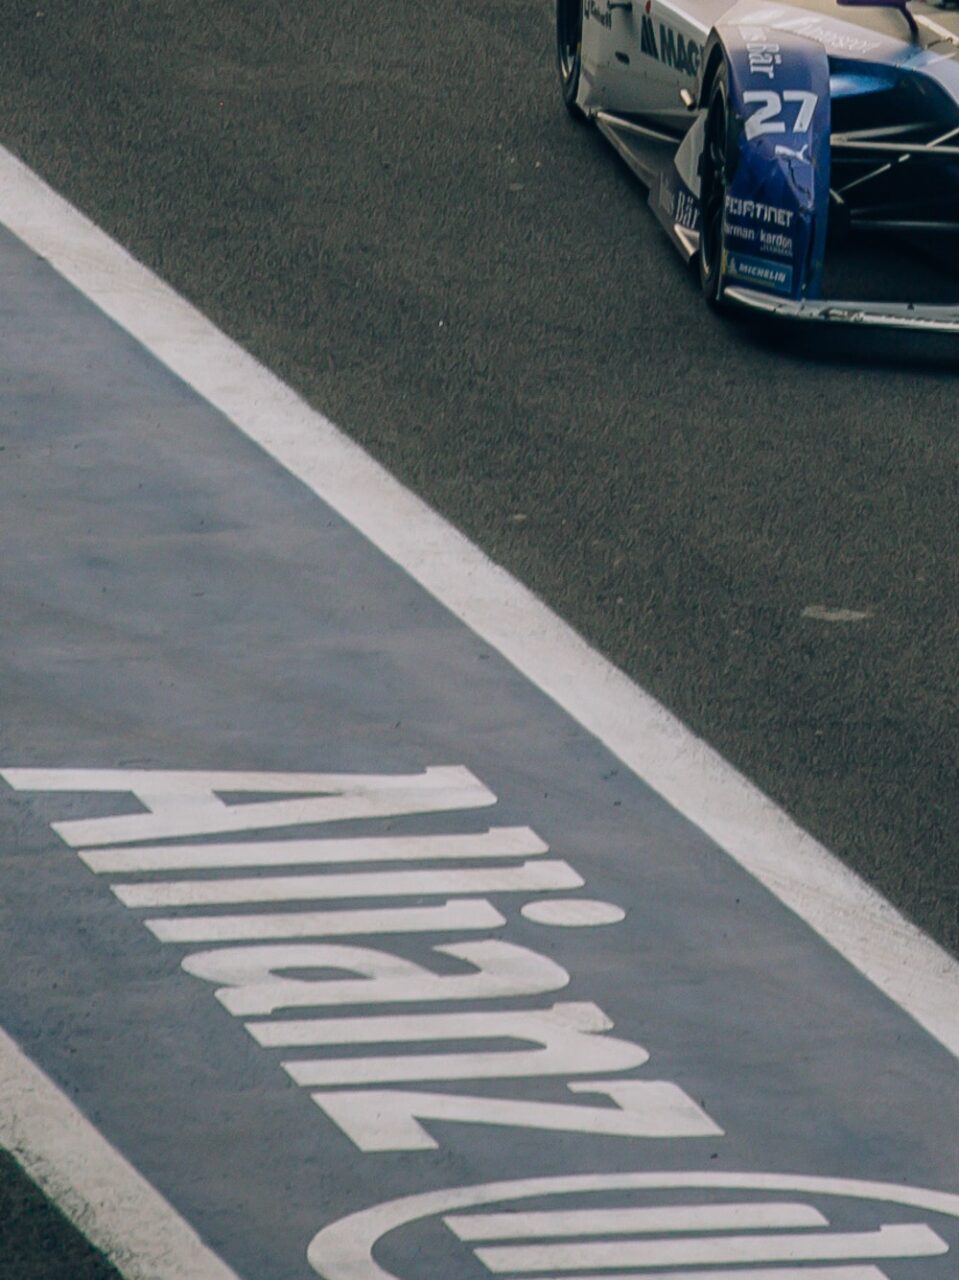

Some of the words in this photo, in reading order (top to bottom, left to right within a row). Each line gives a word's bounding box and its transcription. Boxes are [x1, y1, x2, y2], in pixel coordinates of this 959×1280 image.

[659, 22, 705, 77] MAG
[742, 89, 819, 141] 27
[724, 221, 755, 241] arman
[738, 263, 786, 284] MICHELIN
[0, 764, 725, 1152] Allianz
